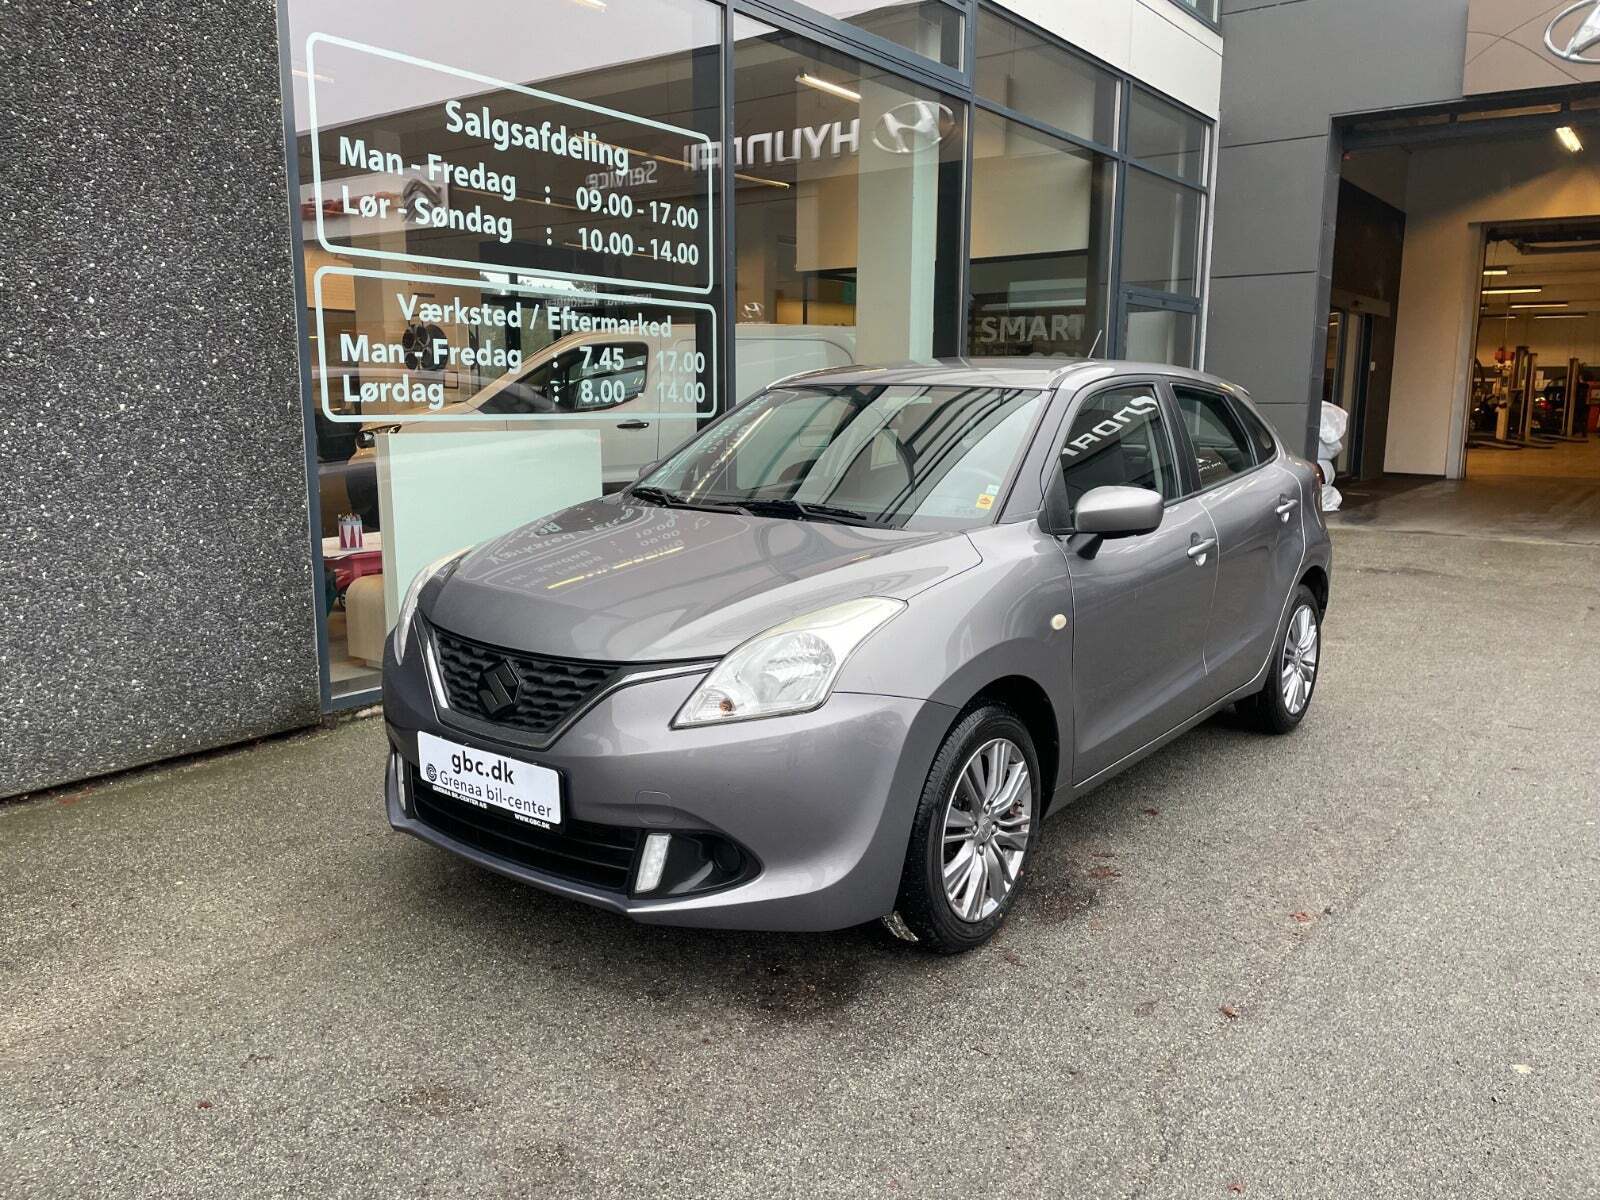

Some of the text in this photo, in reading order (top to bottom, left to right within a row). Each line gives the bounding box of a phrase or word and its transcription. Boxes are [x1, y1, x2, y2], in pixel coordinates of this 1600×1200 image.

[445, 100, 629, 176] Salgsafdeling
[339, 136, 404, 175] Man
[427, 153, 517, 201] Fredag
[576, 186, 633, 218] 09.00
[650, 200, 699, 230] 17.00
[342, 184, 391, 219] Lør
[414, 198, 513, 244] Søndag
[578, 227, 634, 256] 10.00
[650, 238, 699, 265] 14.00
[396, 293, 522, 328] Værksted
[547, 306, 672, 338] Eftermarked
[339, 333, 405, 364] Man
[432, 338, 522, 374] Fredag
[579, 346, 625, 371] 7.45
[656, 350, 706, 373] 17.00
[343, 374, 444, 410] Lørdag
[580, 379, 625, 403] 8.00
[656, 381, 706, 403] 14.00
[451, 750, 514, 785] gbc.dk
[440, 770, 552, 817] Grenaa bil-center
